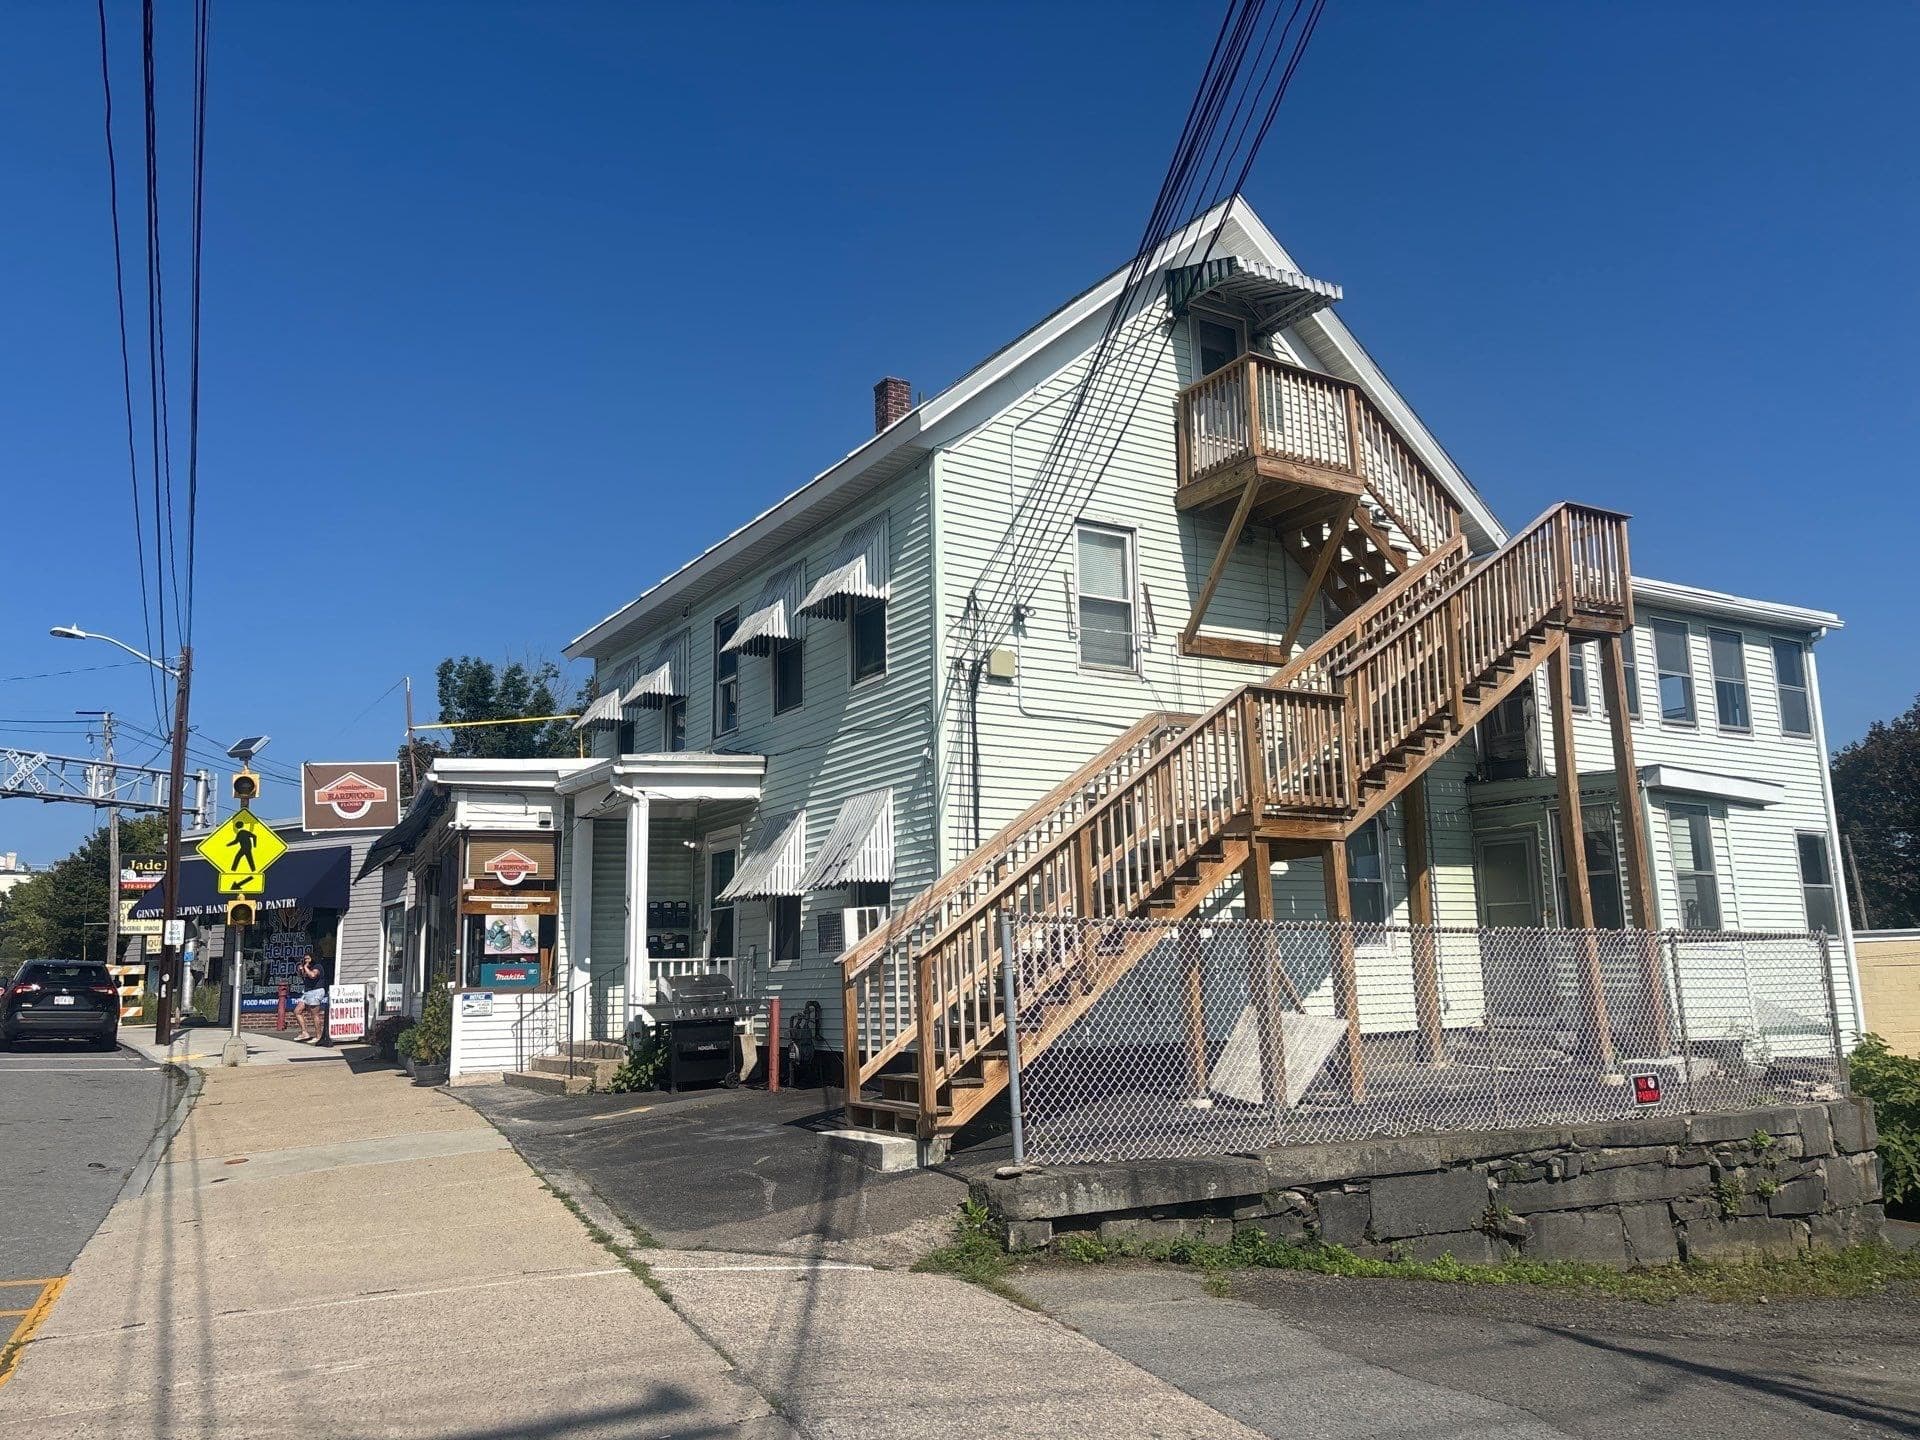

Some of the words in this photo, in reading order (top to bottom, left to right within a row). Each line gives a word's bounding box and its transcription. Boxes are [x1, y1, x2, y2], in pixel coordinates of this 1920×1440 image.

[8, 751, 22, 768] RAIL
[9, 756, 43, 786] CROSSING
[27, 773, 43, 791] ROAD
[327, 792, 375, 800] HARDWOOD
[130, 860, 162, 870] Jade
[177, 904, 203, 916] ELPING
[265, 898, 298, 909] PANTRY
[270, 931, 305, 943] GINNY'S
[259, 998, 279, 1006] PANTRY
[329, 1006, 363, 1019] COMPLETE
[330, 1023, 363, 1035] ALTERATIONS
[1638, 1090, 1659, 1102] PARKING
